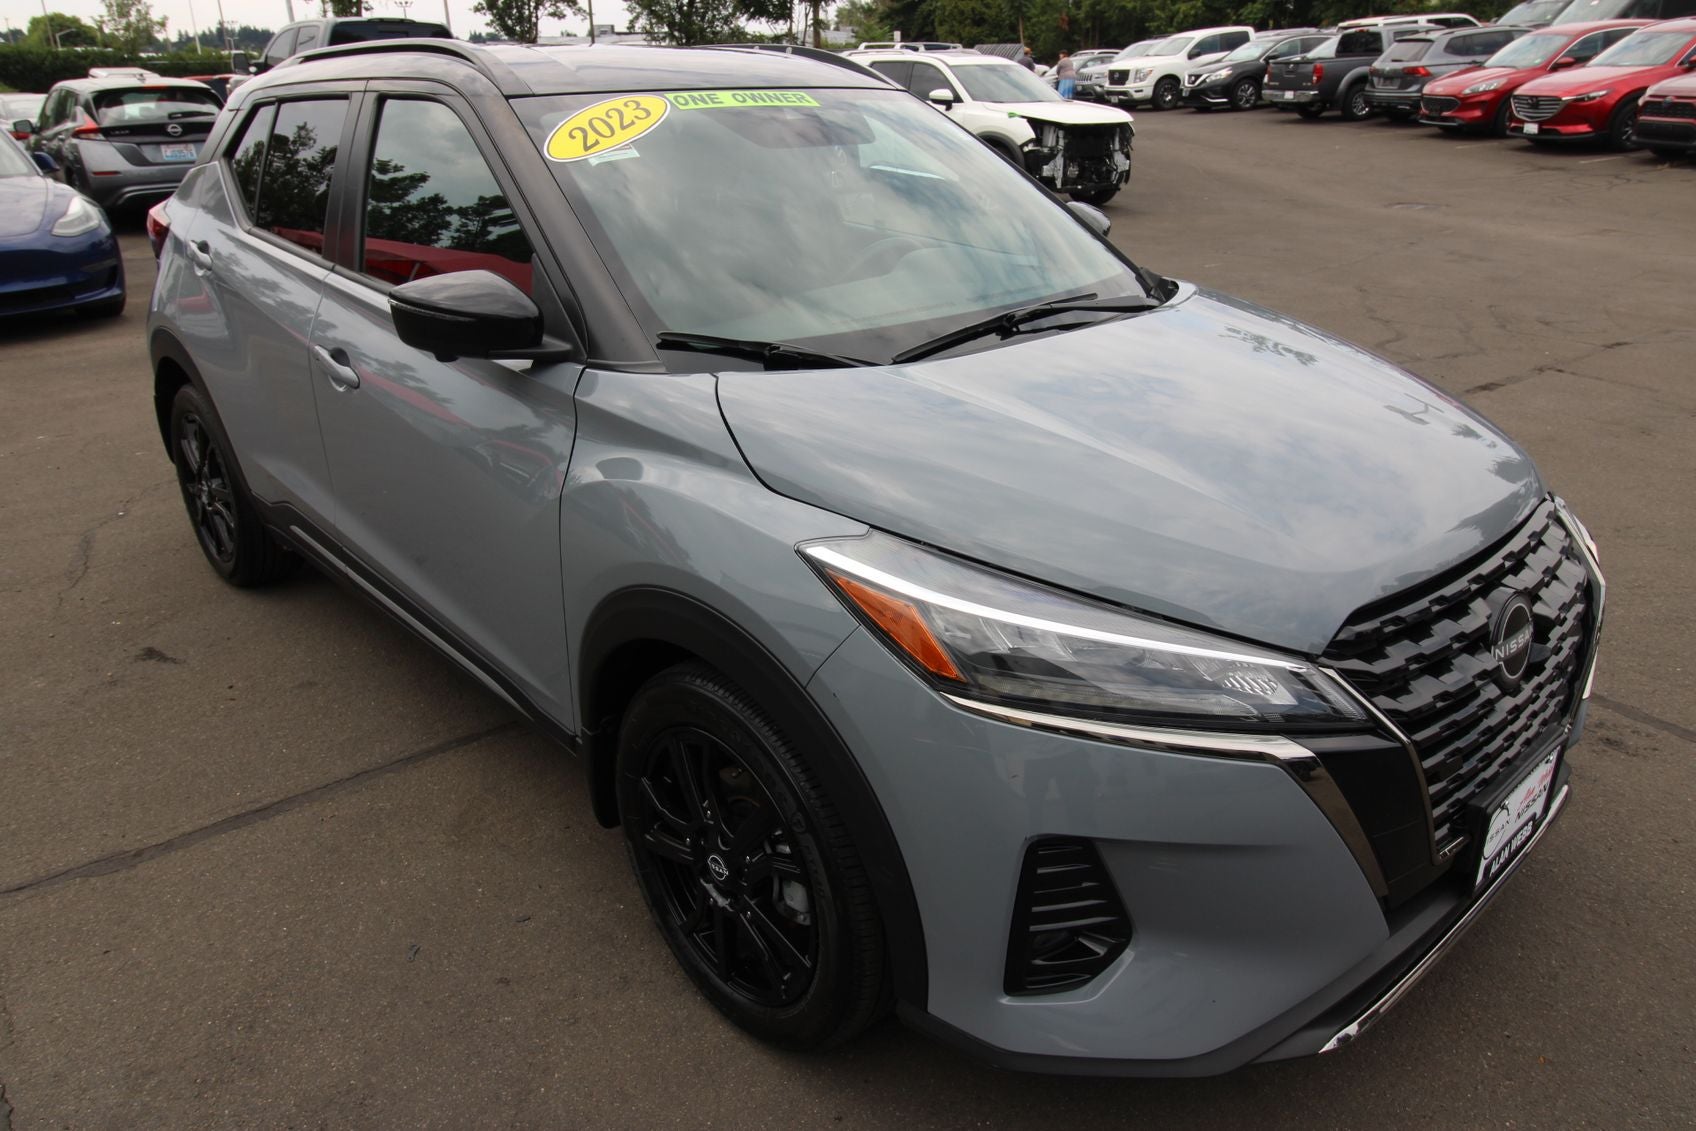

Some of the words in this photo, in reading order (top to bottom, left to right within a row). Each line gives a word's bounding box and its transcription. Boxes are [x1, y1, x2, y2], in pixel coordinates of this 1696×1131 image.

[673, 93, 724, 107] ONE
[734, 92, 811, 105] OWNER
[568, 99, 652, 152] 2023
